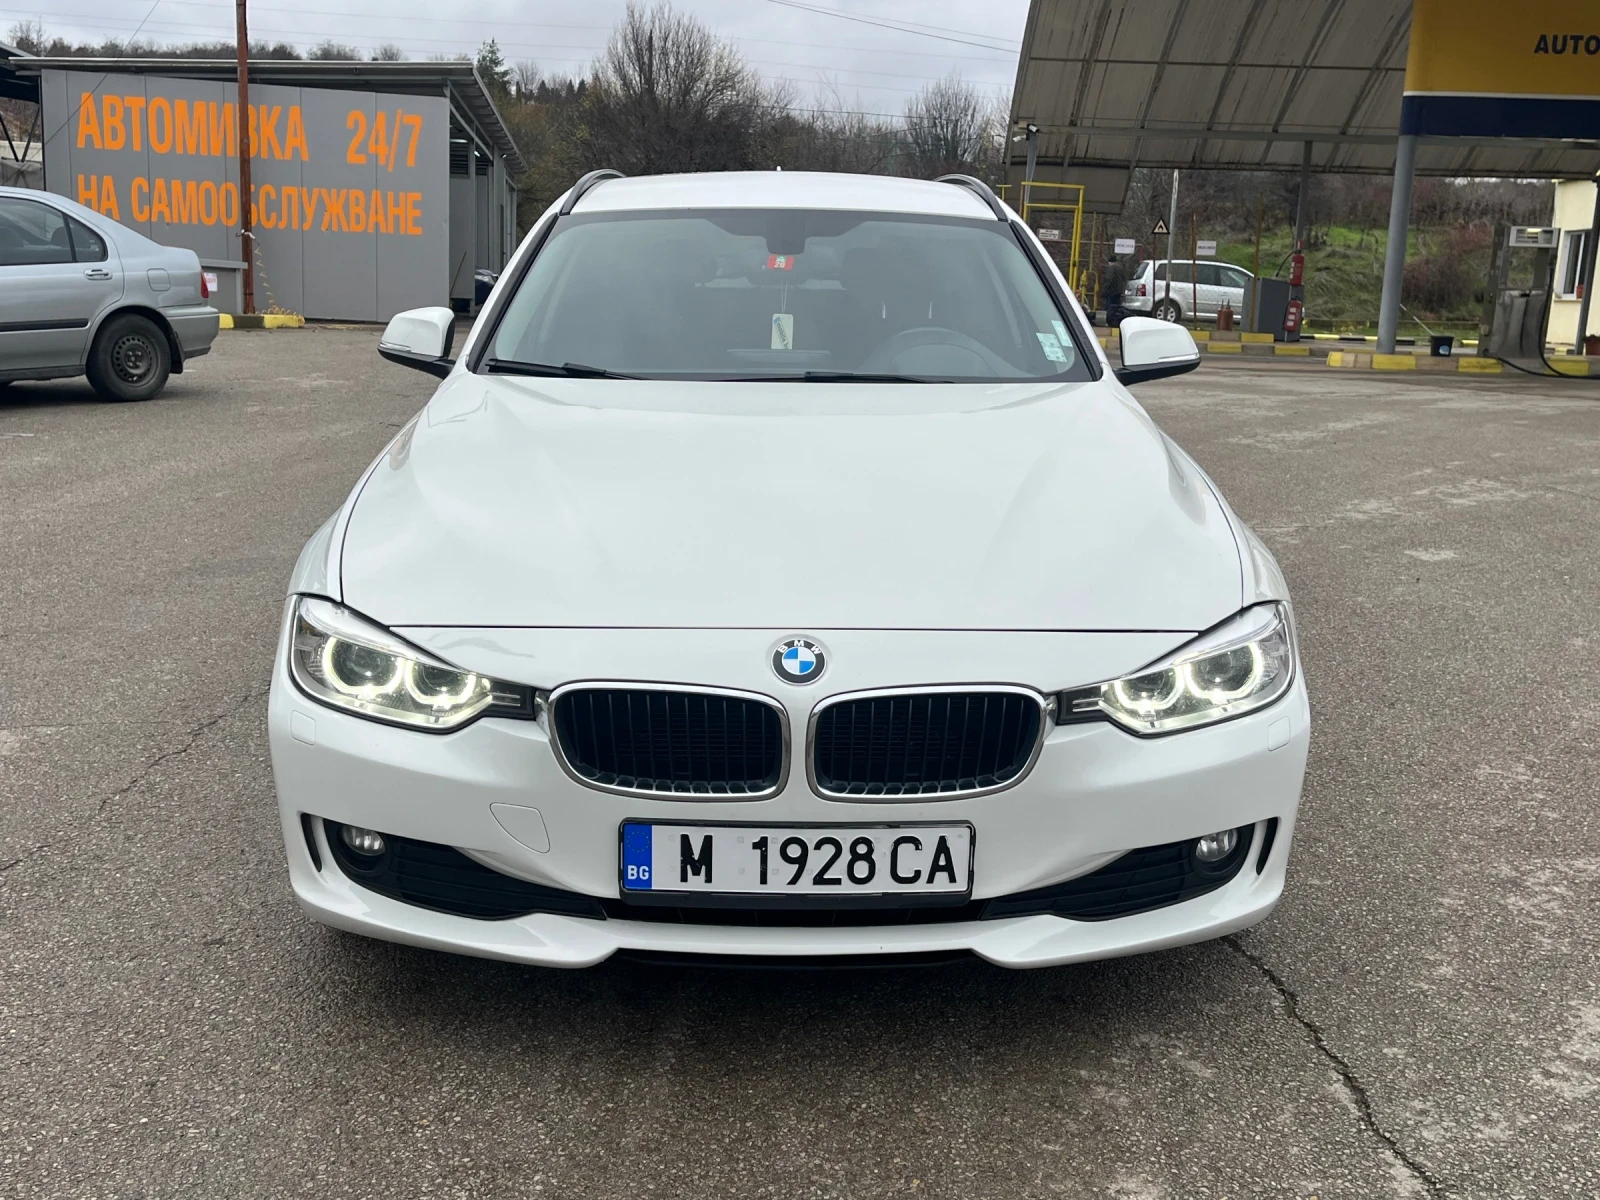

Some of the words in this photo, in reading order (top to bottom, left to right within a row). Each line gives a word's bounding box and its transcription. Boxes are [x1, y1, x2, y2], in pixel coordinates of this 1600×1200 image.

[1533, 33, 1600, 56] AUTO
[77, 92, 309, 162] АВТОМИВКА
[346, 108, 423, 172] 24/7
[77, 174, 120, 221] НА
[777, 639, 822, 655] BMW
[627, 865, 650, 880] BG
[680, 834, 713, 883] M
[752, 836, 876, 885] 1928
